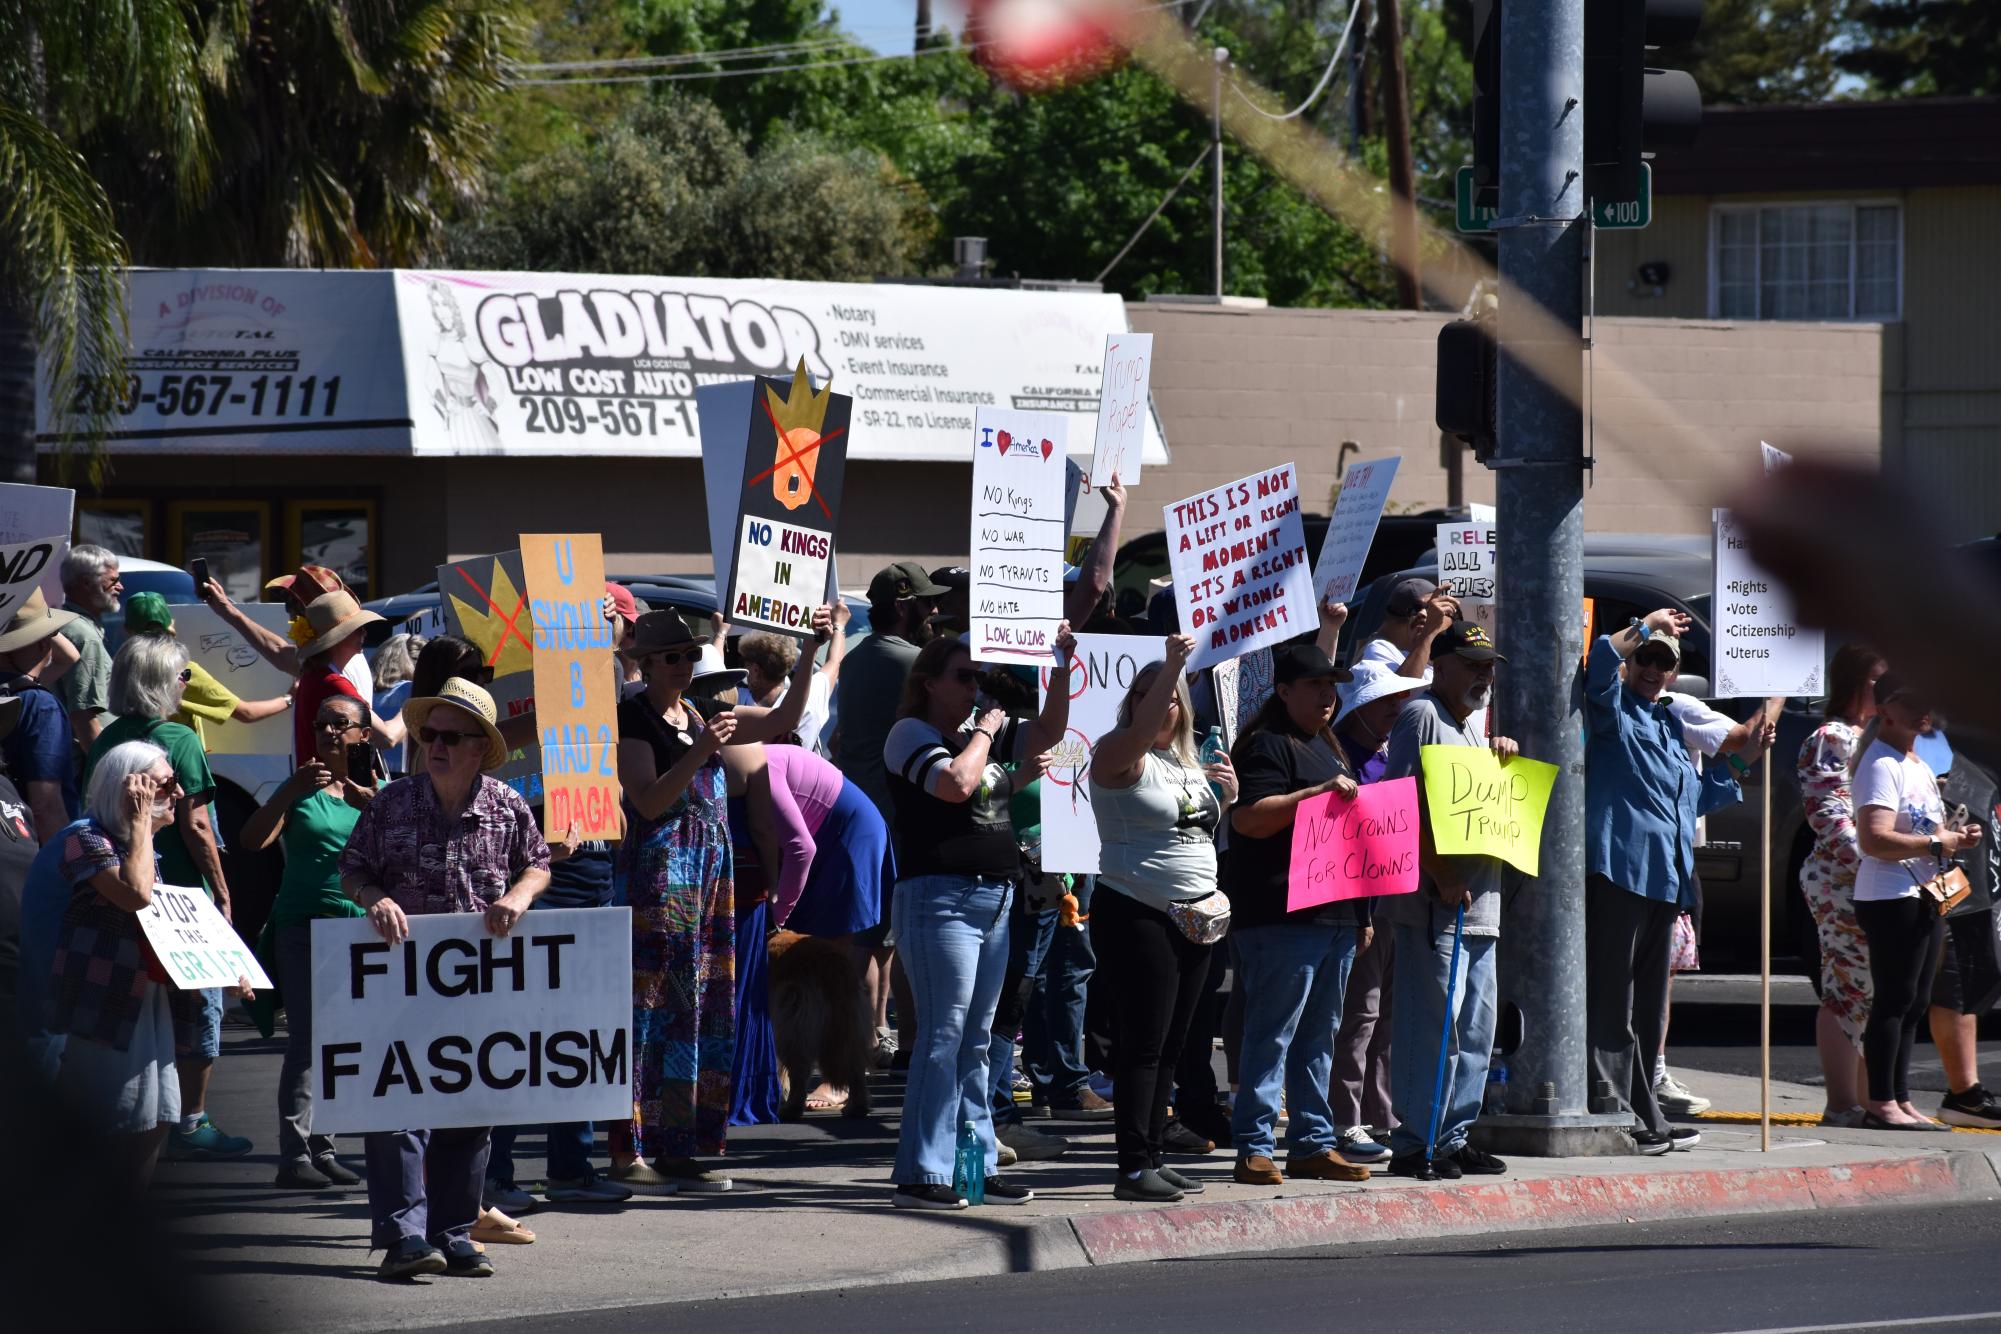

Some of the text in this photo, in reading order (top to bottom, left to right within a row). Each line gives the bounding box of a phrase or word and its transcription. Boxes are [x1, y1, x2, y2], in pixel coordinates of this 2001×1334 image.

[1616, 201, 1640, 223] 100
[177, 284, 259, 308] DIVISION
[261, 296, 287, 319] OF
[832, 304, 877, 325] Notary
[476, 289, 833, 381] GLADIATOR
[840, 331, 924, 350] DMV services
[143, 350, 299, 358] CALIFORNIA PLUS
[848, 359, 948, 378] Event Insurance
[73, 374, 341, 416] 29-567-1111
[508, 367, 563, 392] LOW
[568, 369, 625, 395] COST
[633, 370, 693, 396] AUTO
[856, 385, 995, 406] Commercial Insurance
[1022, 386, 1091, 396] CALIFORNIA
[518, 395, 697, 437] 209-567-1
[908, 415, 923, 429] no
[925, 412, 972, 430] License
[981, 428, 1039, 455] I America
[984, 485, 1033, 514] NO Kings
[1173, 470, 1290, 528] THIS IS NOT
[981, 528, 1025, 544] NO WAR
[1180, 496, 1299, 553] A LEFT OR RIGHT
[1450, 530, 1496, 545] RELE
[749, 521, 829, 560] NO KINGS
[1202, 527, 1281, 573] MOMENT
[1727, 537, 1748, 550] Ha
[554, 538, 575, 585] U
[774, 561, 792, 586] IN
[980, 565, 994, 578] NO
[999, 565, 1049, 583] TYRANTS
[1190, 575, 1225, 604] IT'S
[1232, 569, 1246, 588] A
[1252, 546, 1304, 581] RIGHT
[1444, 552, 1480, 572] ALL
[1731, 580, 1768, 596] Rights
[735, 592, 812, 630] AMERICA
[980, 599, 1020, 614] NO HATE
[1192, 582, 1285, 629] OR WRONG
[1731, 603, 1758, 615] Vote
[405, 617, 422, 635] NO
[532, 597, 613, 650] SHOULD
[985, 623, 1046, 646] LOVE WINS
[1211, 605, 1289, 649] MOMENT
[1730, 623, 1796, 640] Citizenship
[1730, 647, 1770, 659] Uterus
[1089, 651, 1138, 689] NO
[569, 661, 585, 709] B
[543, 724, 613, 776] MAD 2
[551, 785, 618, 833] MAGA
[1304, 810, 1335, 852] NO
[152, 889, 199, 923] STOP
[174, 928, 209, 944] THE
[169, 950, 255, 981] GRIFT
[350, 933, 576, 1000] FIGHT
[321, 1028, 627, 1100] FASCISM
